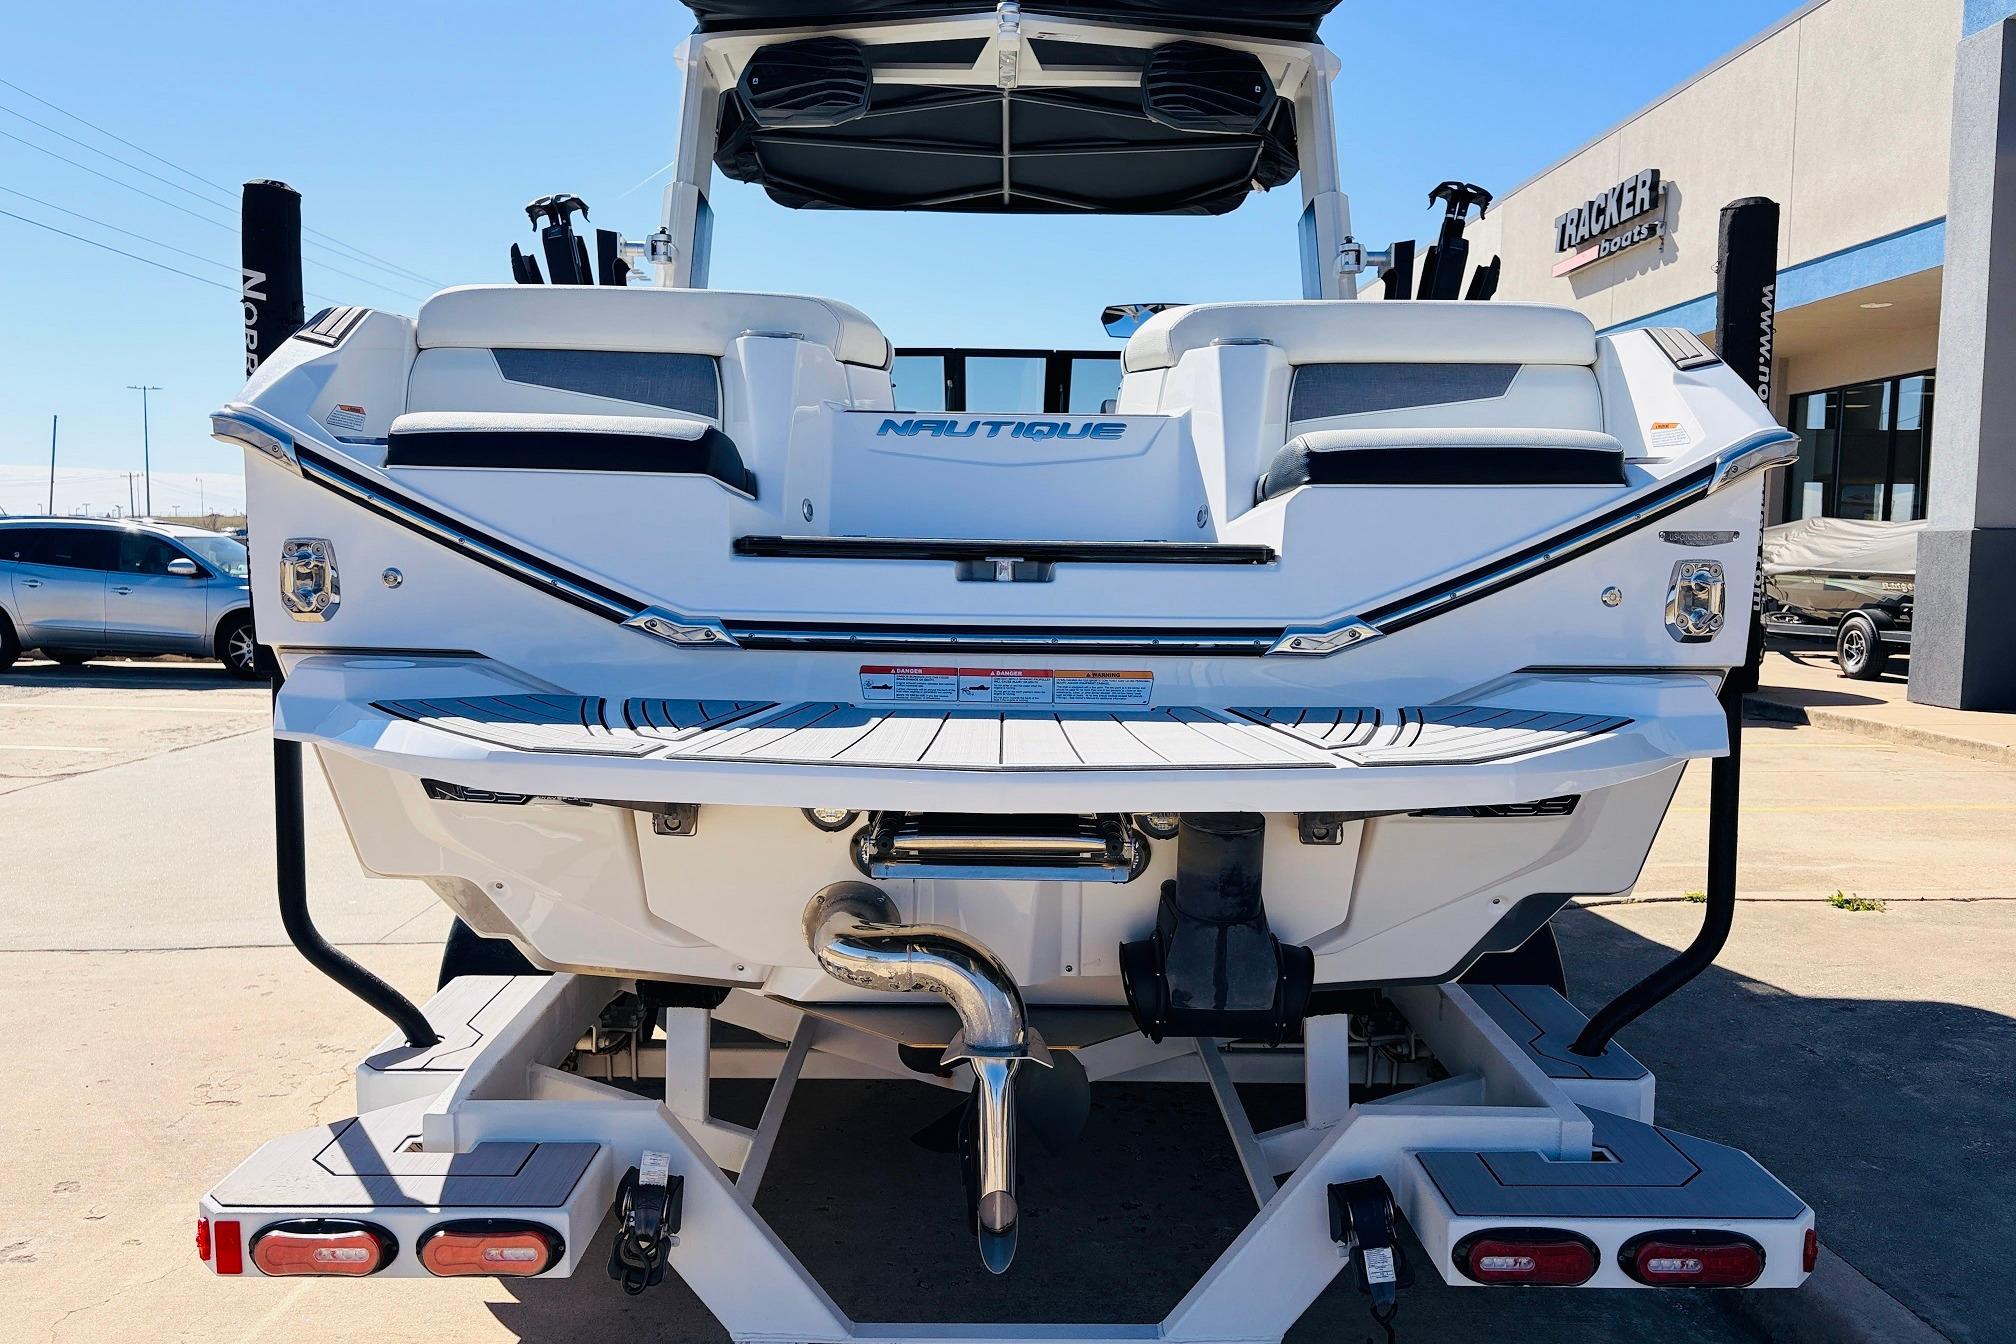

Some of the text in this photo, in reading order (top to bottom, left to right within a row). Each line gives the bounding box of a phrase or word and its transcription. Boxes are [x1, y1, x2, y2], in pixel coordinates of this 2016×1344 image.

[1554, 168, 1659, 253] TRACKER
[1599, 223, 1655, 258] boats
[876, 418, 1128, 442] NAUTIQUE
[1881, 581, 1915, 593] Range
